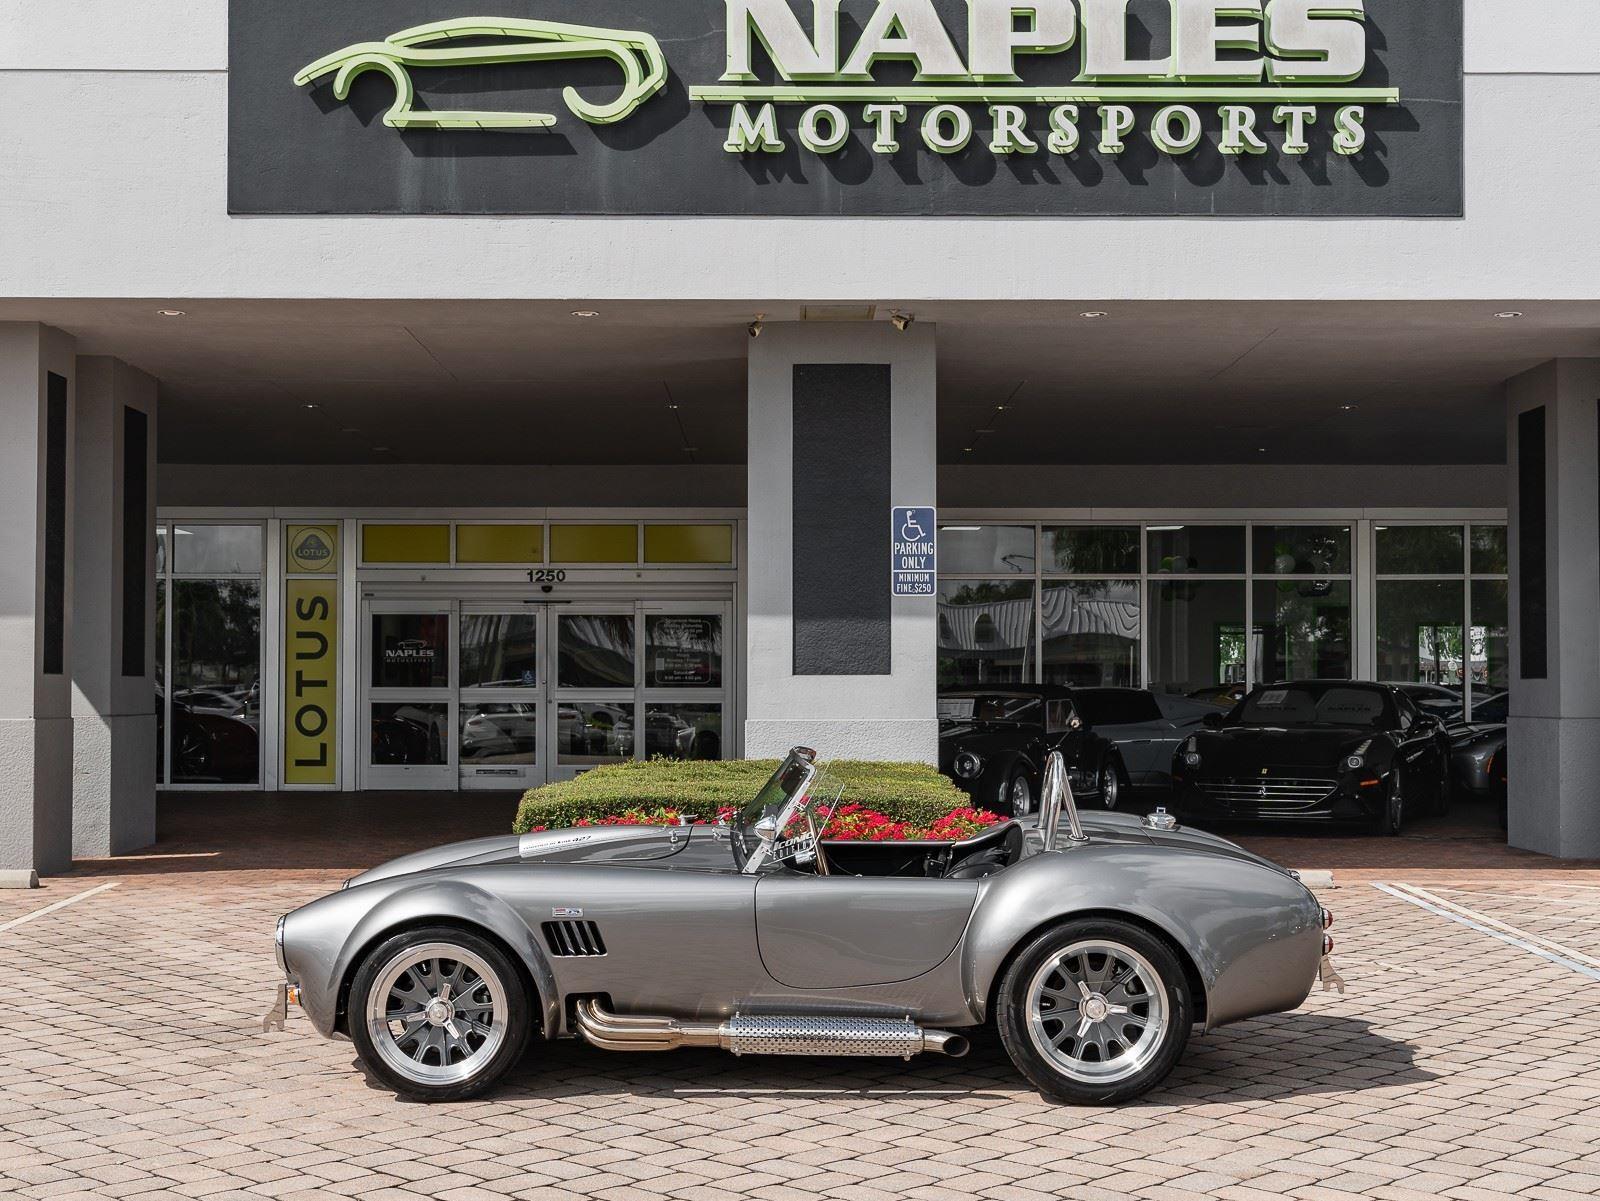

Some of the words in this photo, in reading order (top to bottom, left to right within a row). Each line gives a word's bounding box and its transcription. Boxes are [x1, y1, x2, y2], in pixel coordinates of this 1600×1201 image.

[718, 0, 1367, 82] NAPLES
[723, 102, 1367, 154] MOTORSPORTS
[297, 548, 329, 557] LOTUS
[894, 542, 934, 555] PARKING
[901, 556, 926, 569] ONLY
[527, 569, 567, 582] 1250
[898, 573, 930, 582] MINIMUM
[896, 583, 912, 593] FINE
[913, 583, 932, 593] $250
[385, 649, 435, 657] NAPLES
[294, 595, 330, 768] LOTUS
